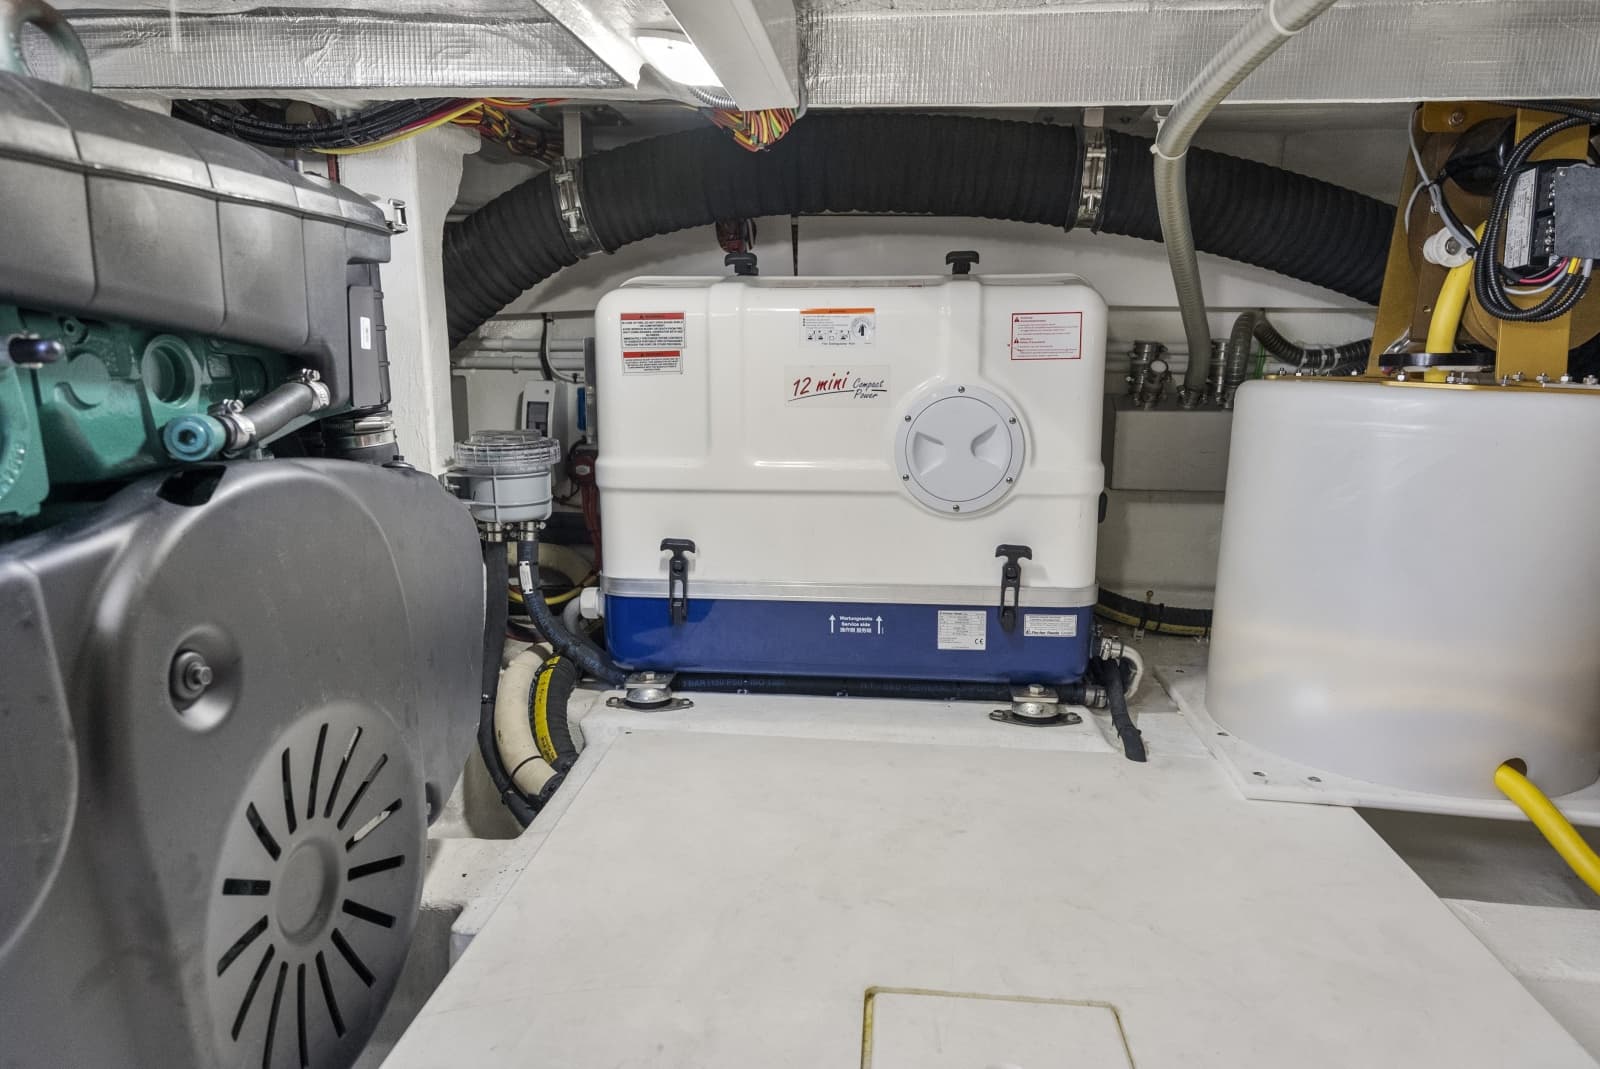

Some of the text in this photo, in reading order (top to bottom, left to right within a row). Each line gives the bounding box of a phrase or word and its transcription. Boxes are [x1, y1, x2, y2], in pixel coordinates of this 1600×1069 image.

[793, 371, 885, 397] 12 mini Compact
[853, 389, 879, 399] Power
